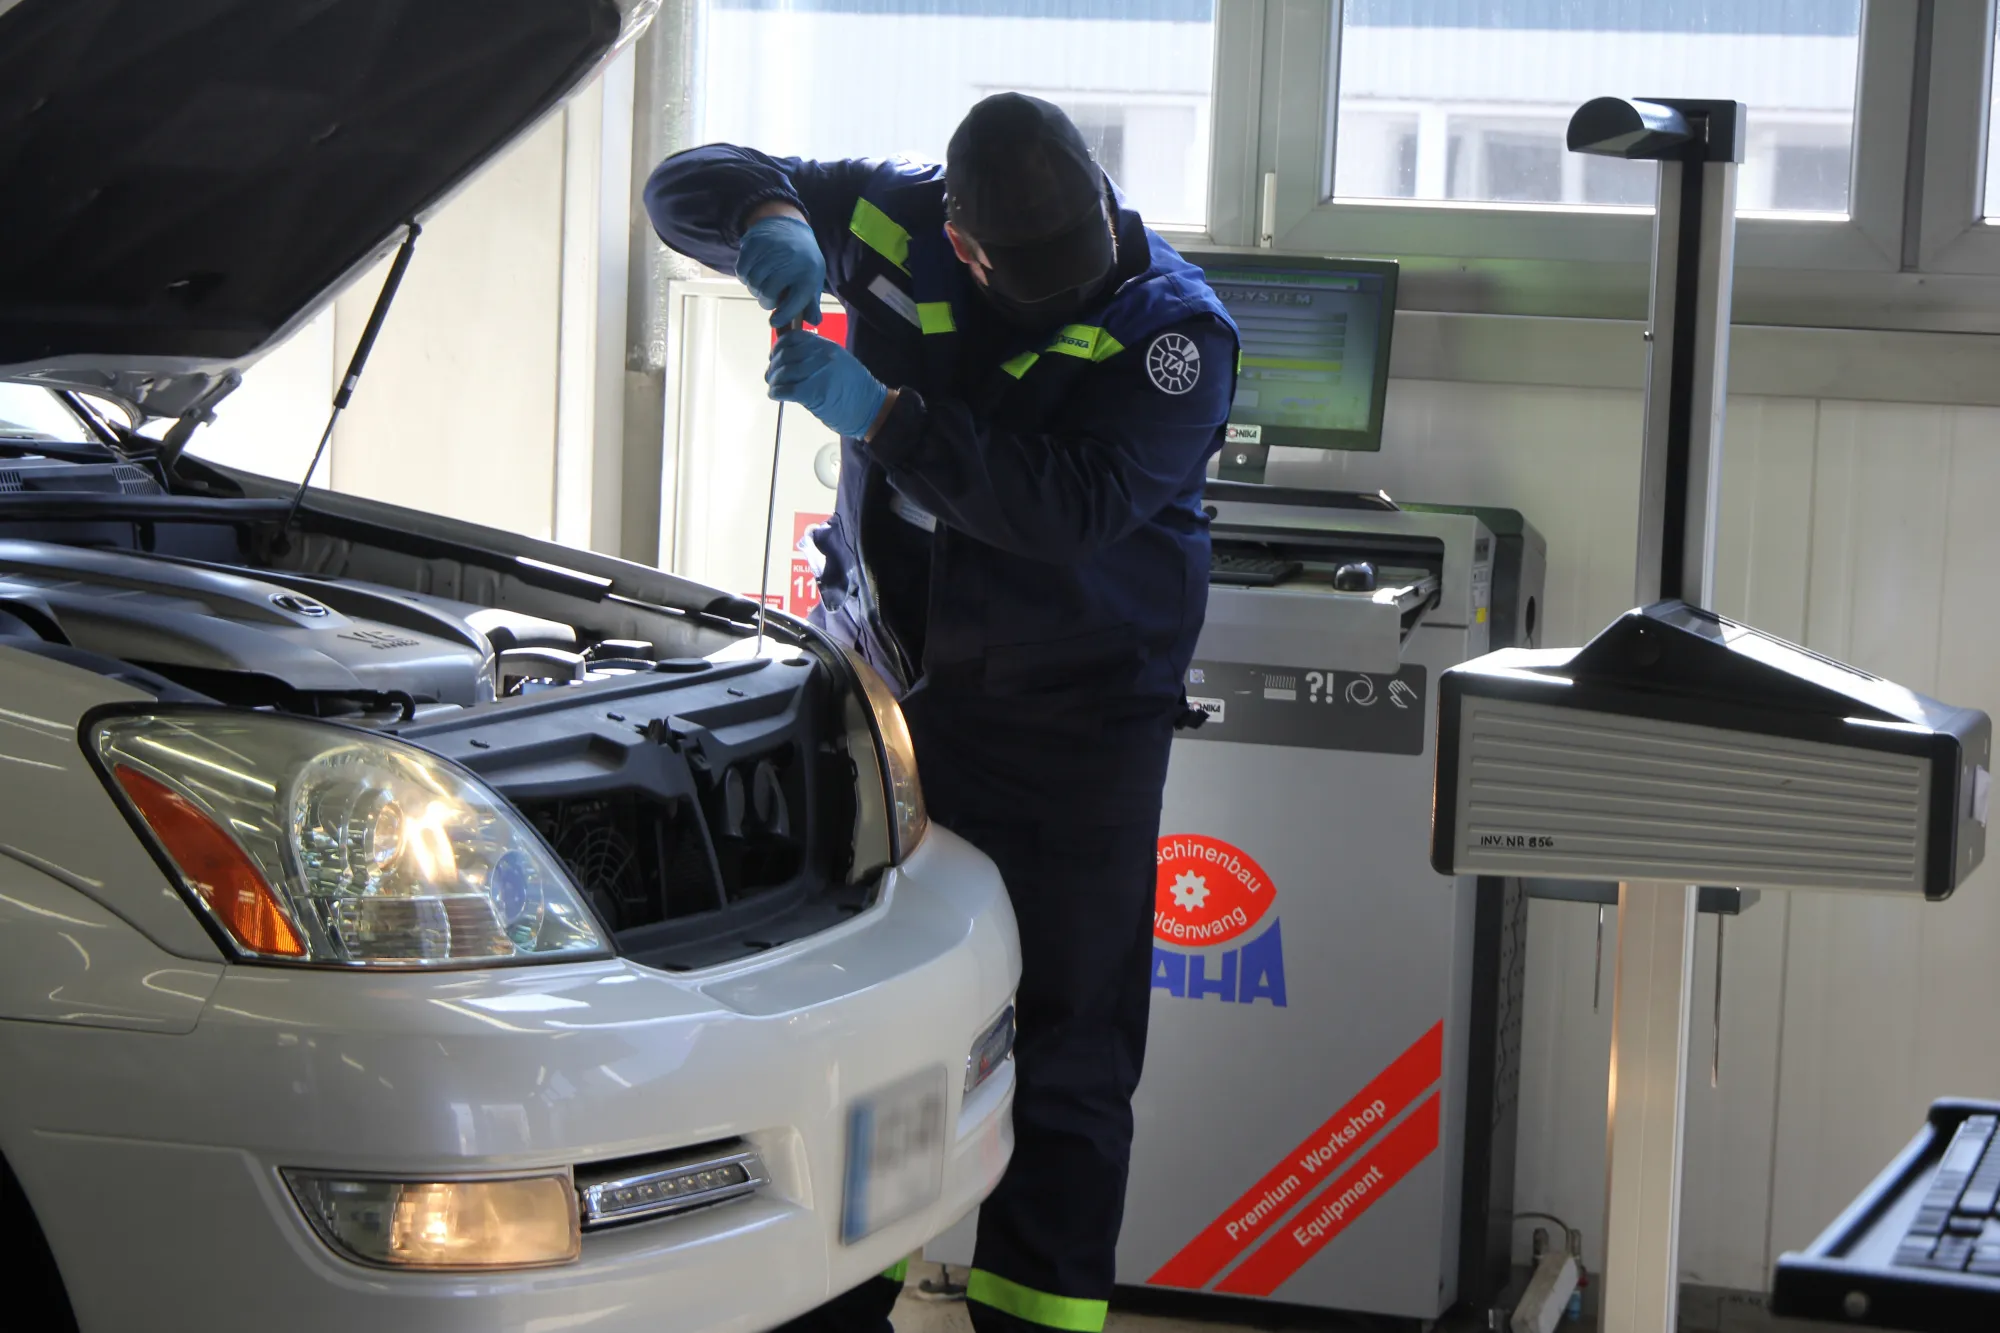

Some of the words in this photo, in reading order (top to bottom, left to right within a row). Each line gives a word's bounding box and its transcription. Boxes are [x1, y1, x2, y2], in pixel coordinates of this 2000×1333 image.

[1164, 352, 1184, 375] TA
[1225, 1173, 1301, 1241] Premium
[1299, 1099, 1387, 1174] Workshop
[1292, 1165, 1384, 1248] Equipment
